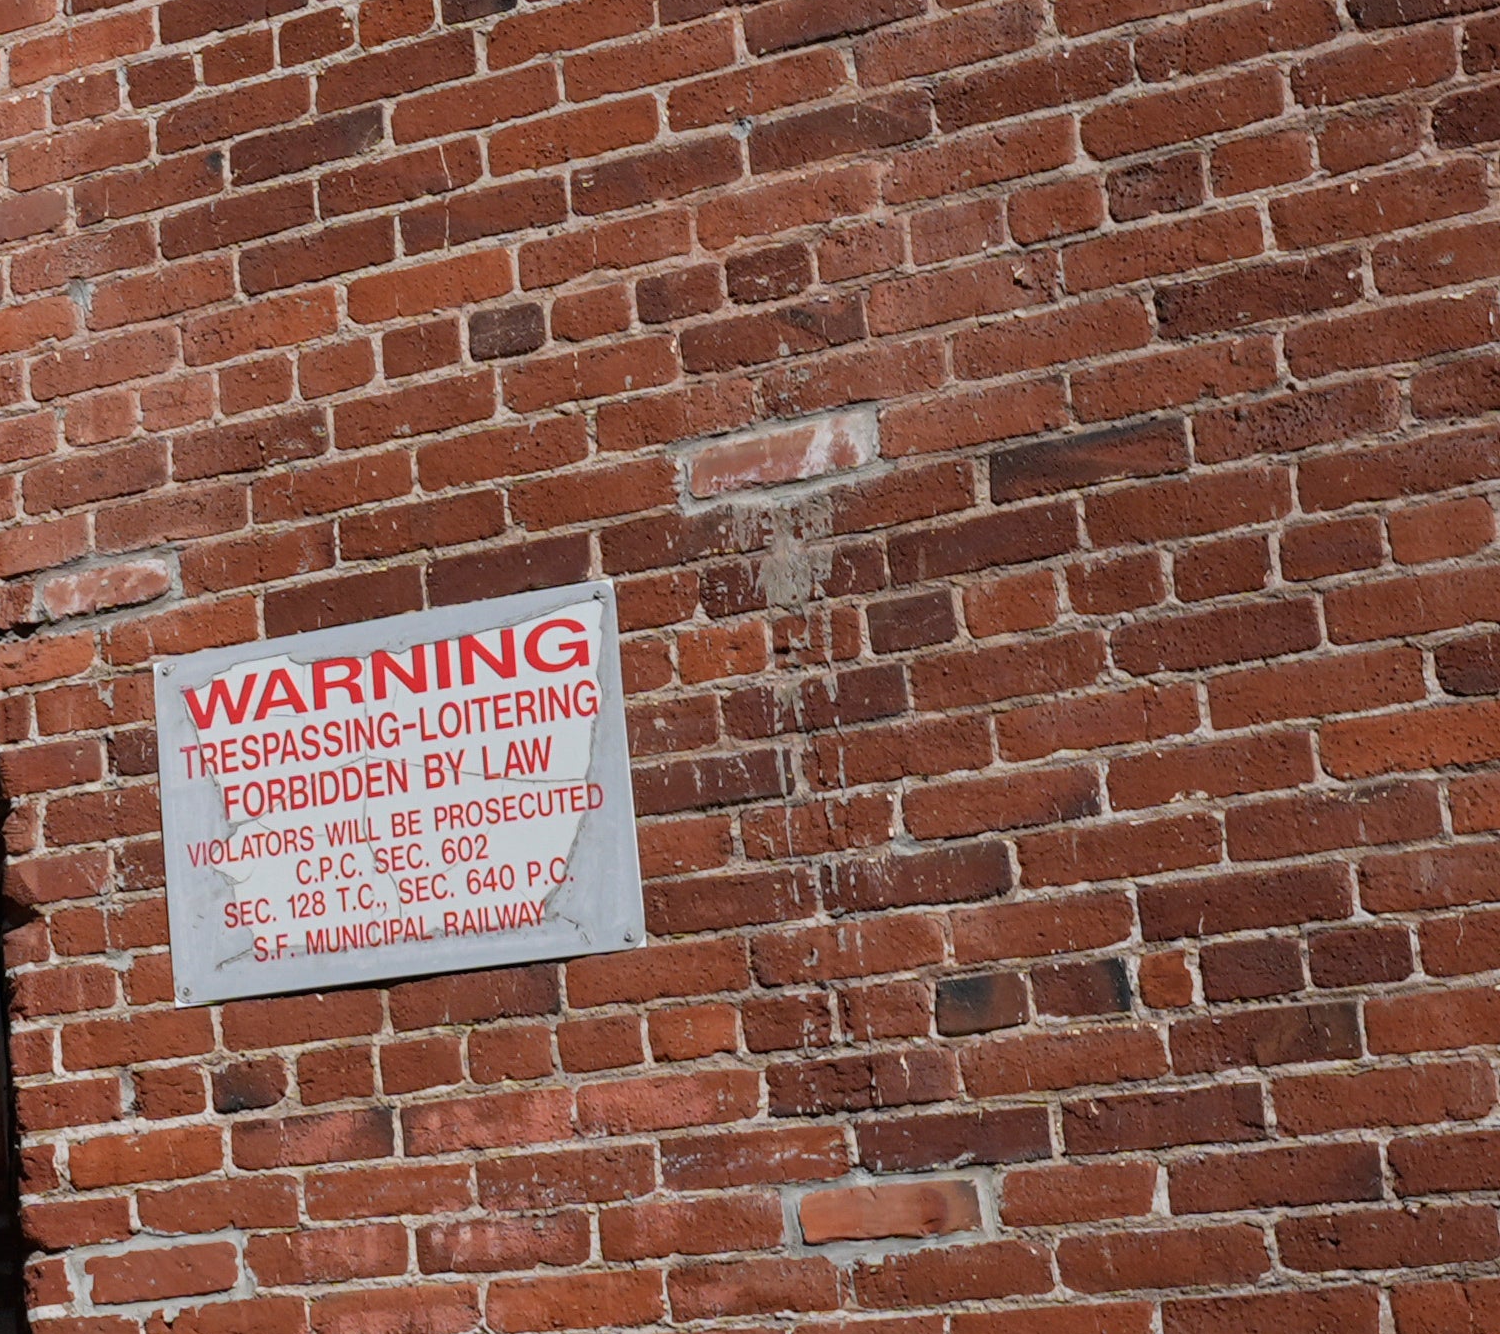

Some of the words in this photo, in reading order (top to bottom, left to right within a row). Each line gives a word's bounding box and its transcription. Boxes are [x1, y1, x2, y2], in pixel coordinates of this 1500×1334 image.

[180, 618, 590, 730] WARNING
[180, 679, 599, 780] TRESPASSING-LOITERING
[223, 758, 409, 821] FORBIDDEN
[423, 748, 466, 790] BY
[482, 735, 552, 781] LAW
[186, 825, 315, 868] VIOLATORS
[324, 816, 381, 848] WILL
[391, 809, 423, 839] BE
[434, 783, 604, 832] PROSECUTED
[296, 852, 363, 885] C.P.C.
[374, 842, 430, 875] SEC.
[441, 833, 489, 865] 602
[223, 898, 277, 929] SEC.
[287, 890, 327, 919] 128
[335, 883, 388, 917] T.C.,
[398, 873, 455, 905] SEC.
[466, 863, 516, 895] 640
[526, 856, 574, 887] P.C.
[253, 933, 296, 963] S.F.
[305, 915, 433, 956] MUNICIPAL
[443, 898, 547, 938] RAILWAY
